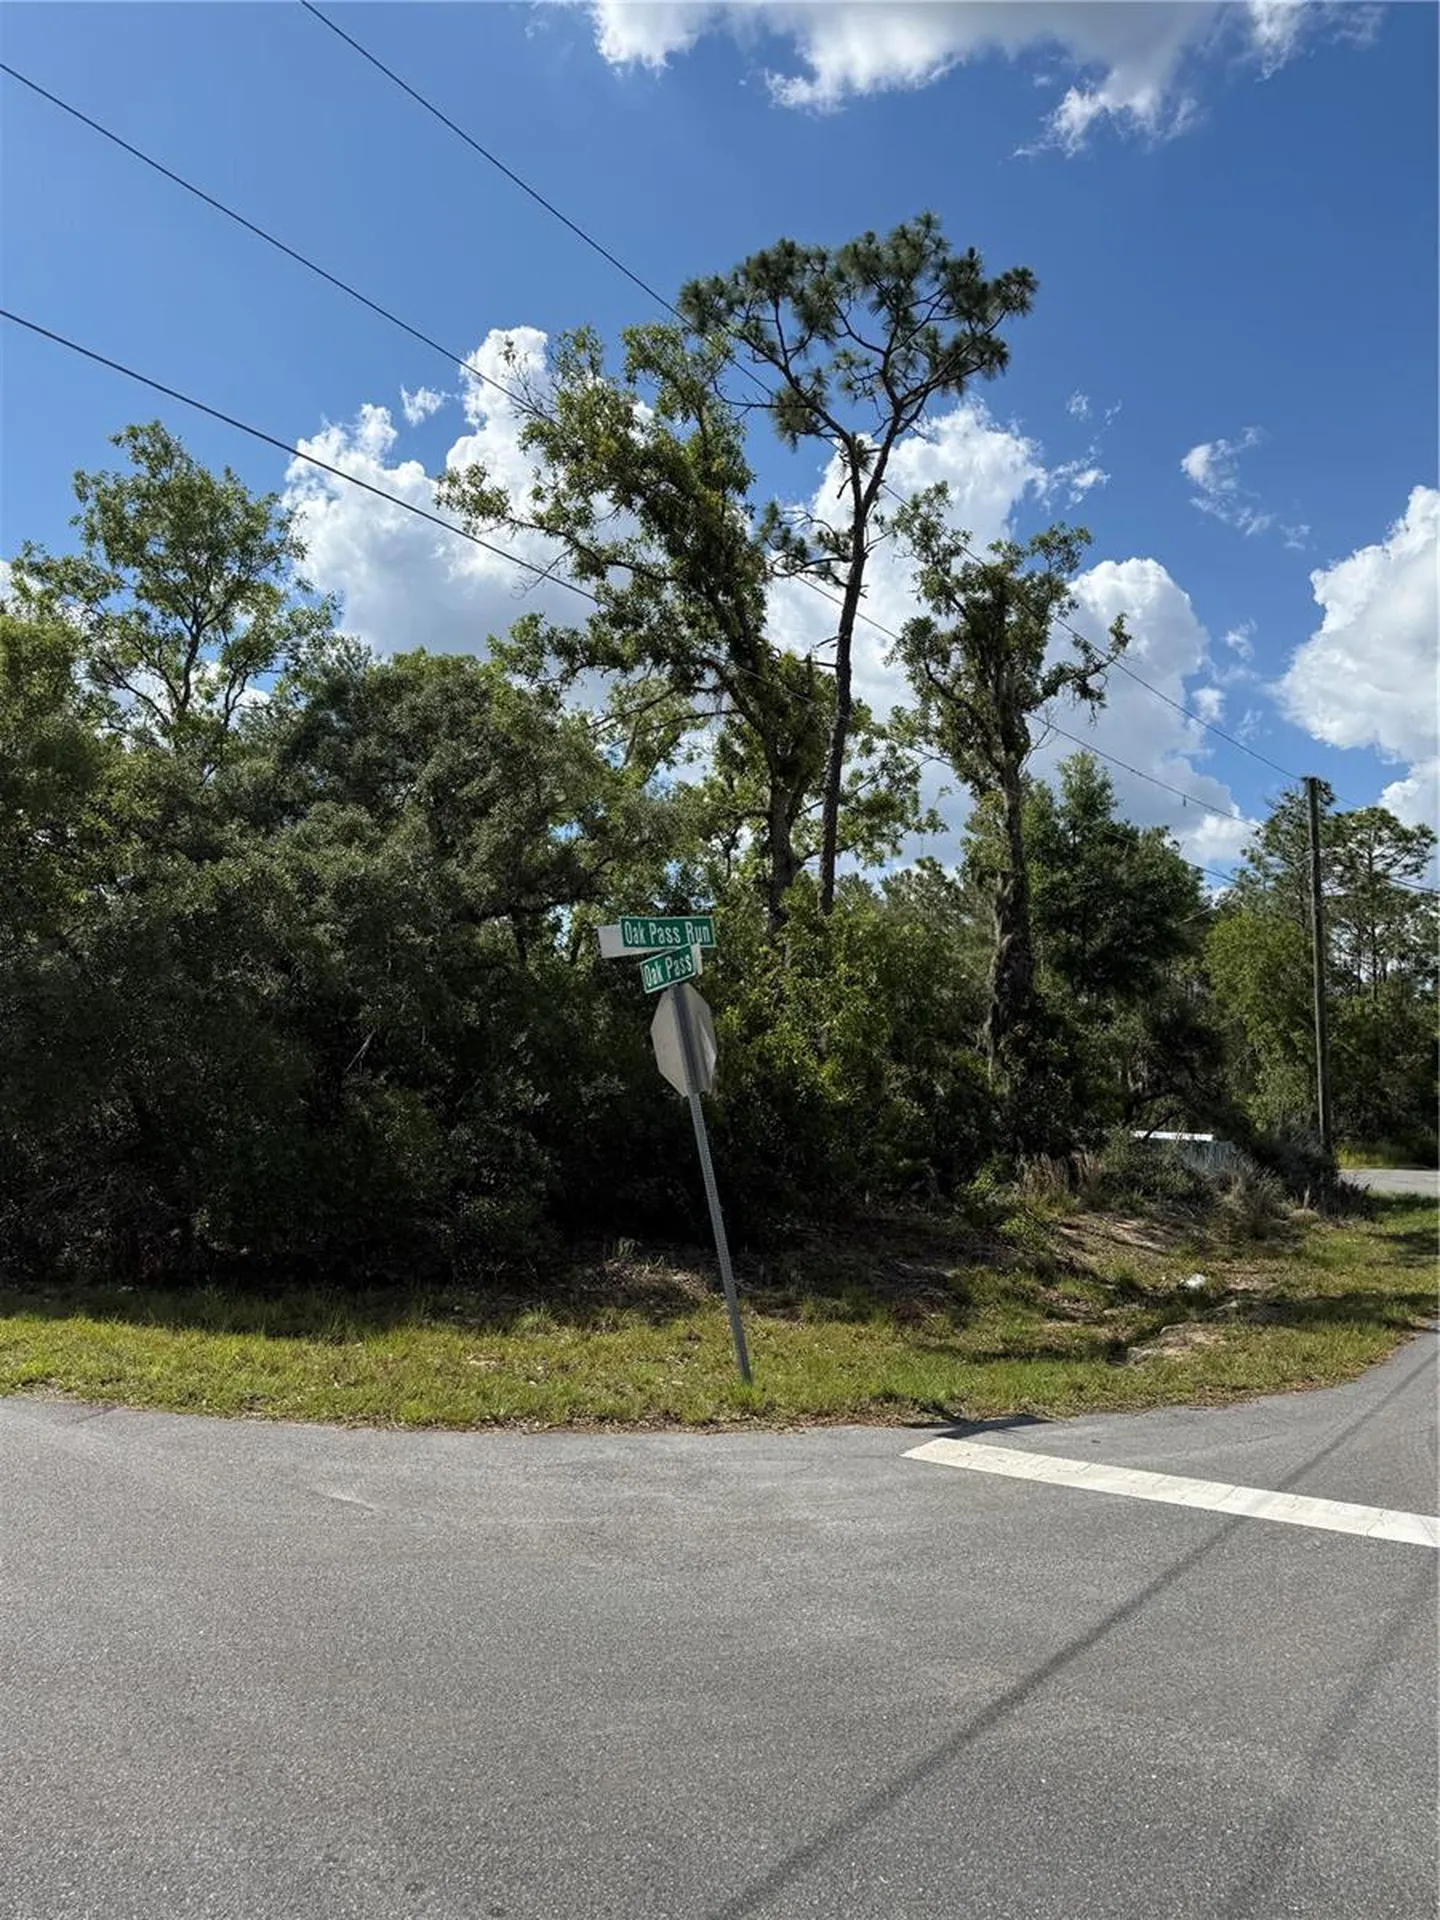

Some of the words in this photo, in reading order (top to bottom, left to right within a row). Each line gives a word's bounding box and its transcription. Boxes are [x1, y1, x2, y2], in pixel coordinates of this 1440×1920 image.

[624, 921, 647, 944] Oak
[648, 922, 681, 944] Pass
[685, 921, 711, 944] Run
[644, 961, 664, 987] Oak
[665, 954, 692, 980] Pass
